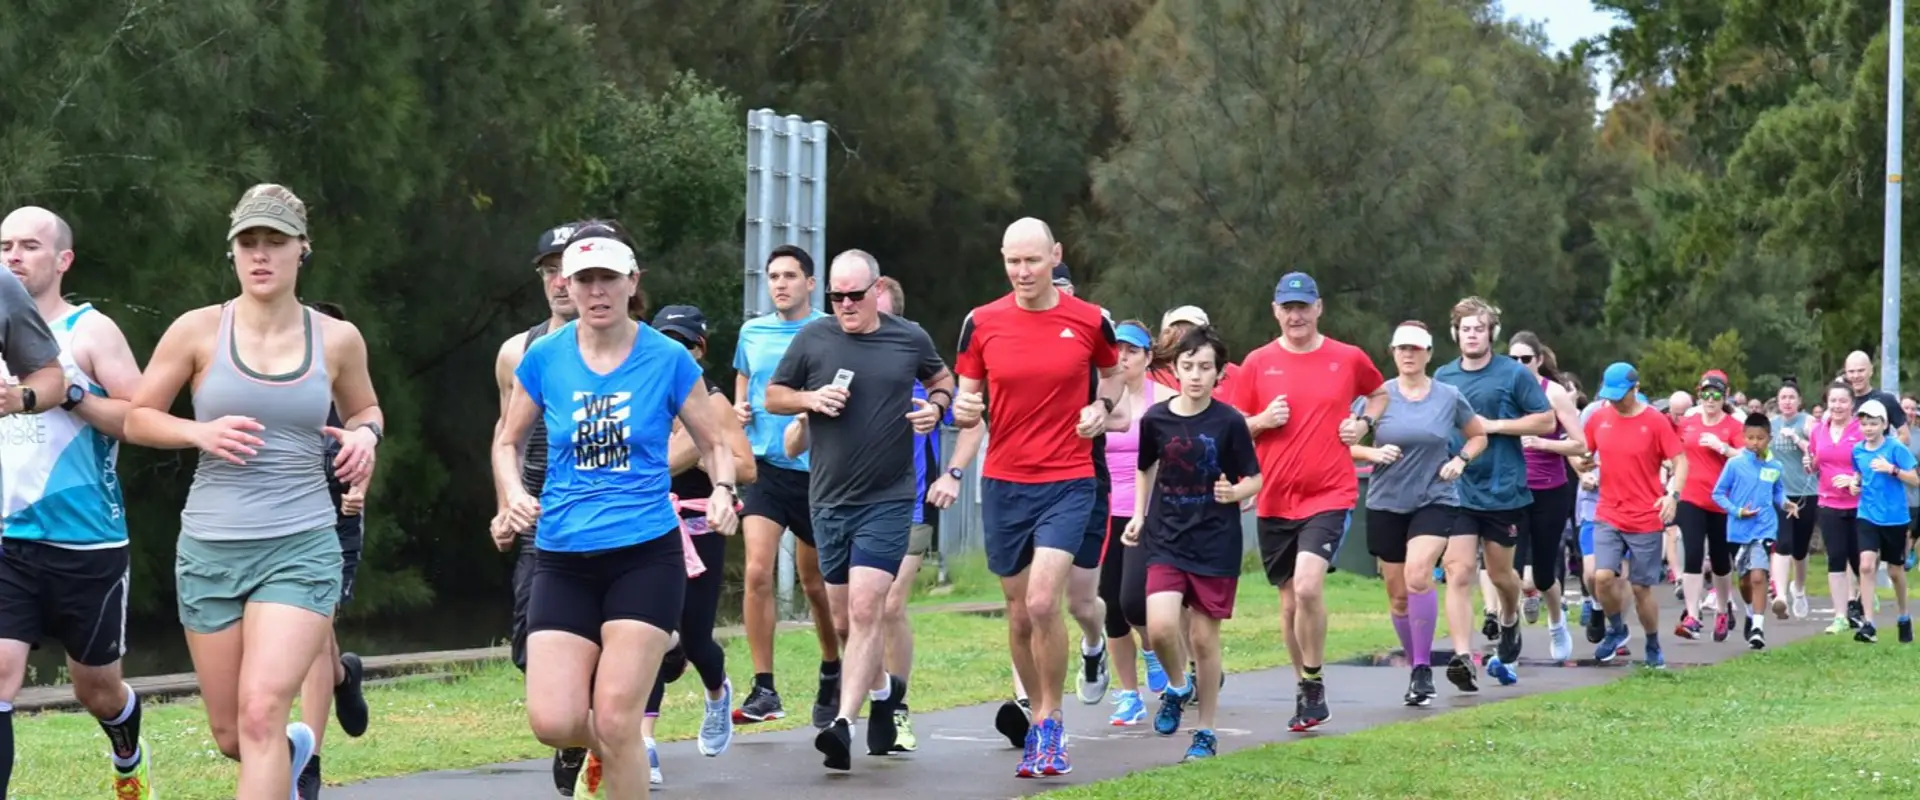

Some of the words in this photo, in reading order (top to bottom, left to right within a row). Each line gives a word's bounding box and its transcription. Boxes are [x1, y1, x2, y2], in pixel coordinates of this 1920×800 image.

[583, 394, 618, 419] WE
[0, 413, 46, 428] OVE
[578, 420, 624, 446] RUN
[576, 445, 629, 468] MUM
